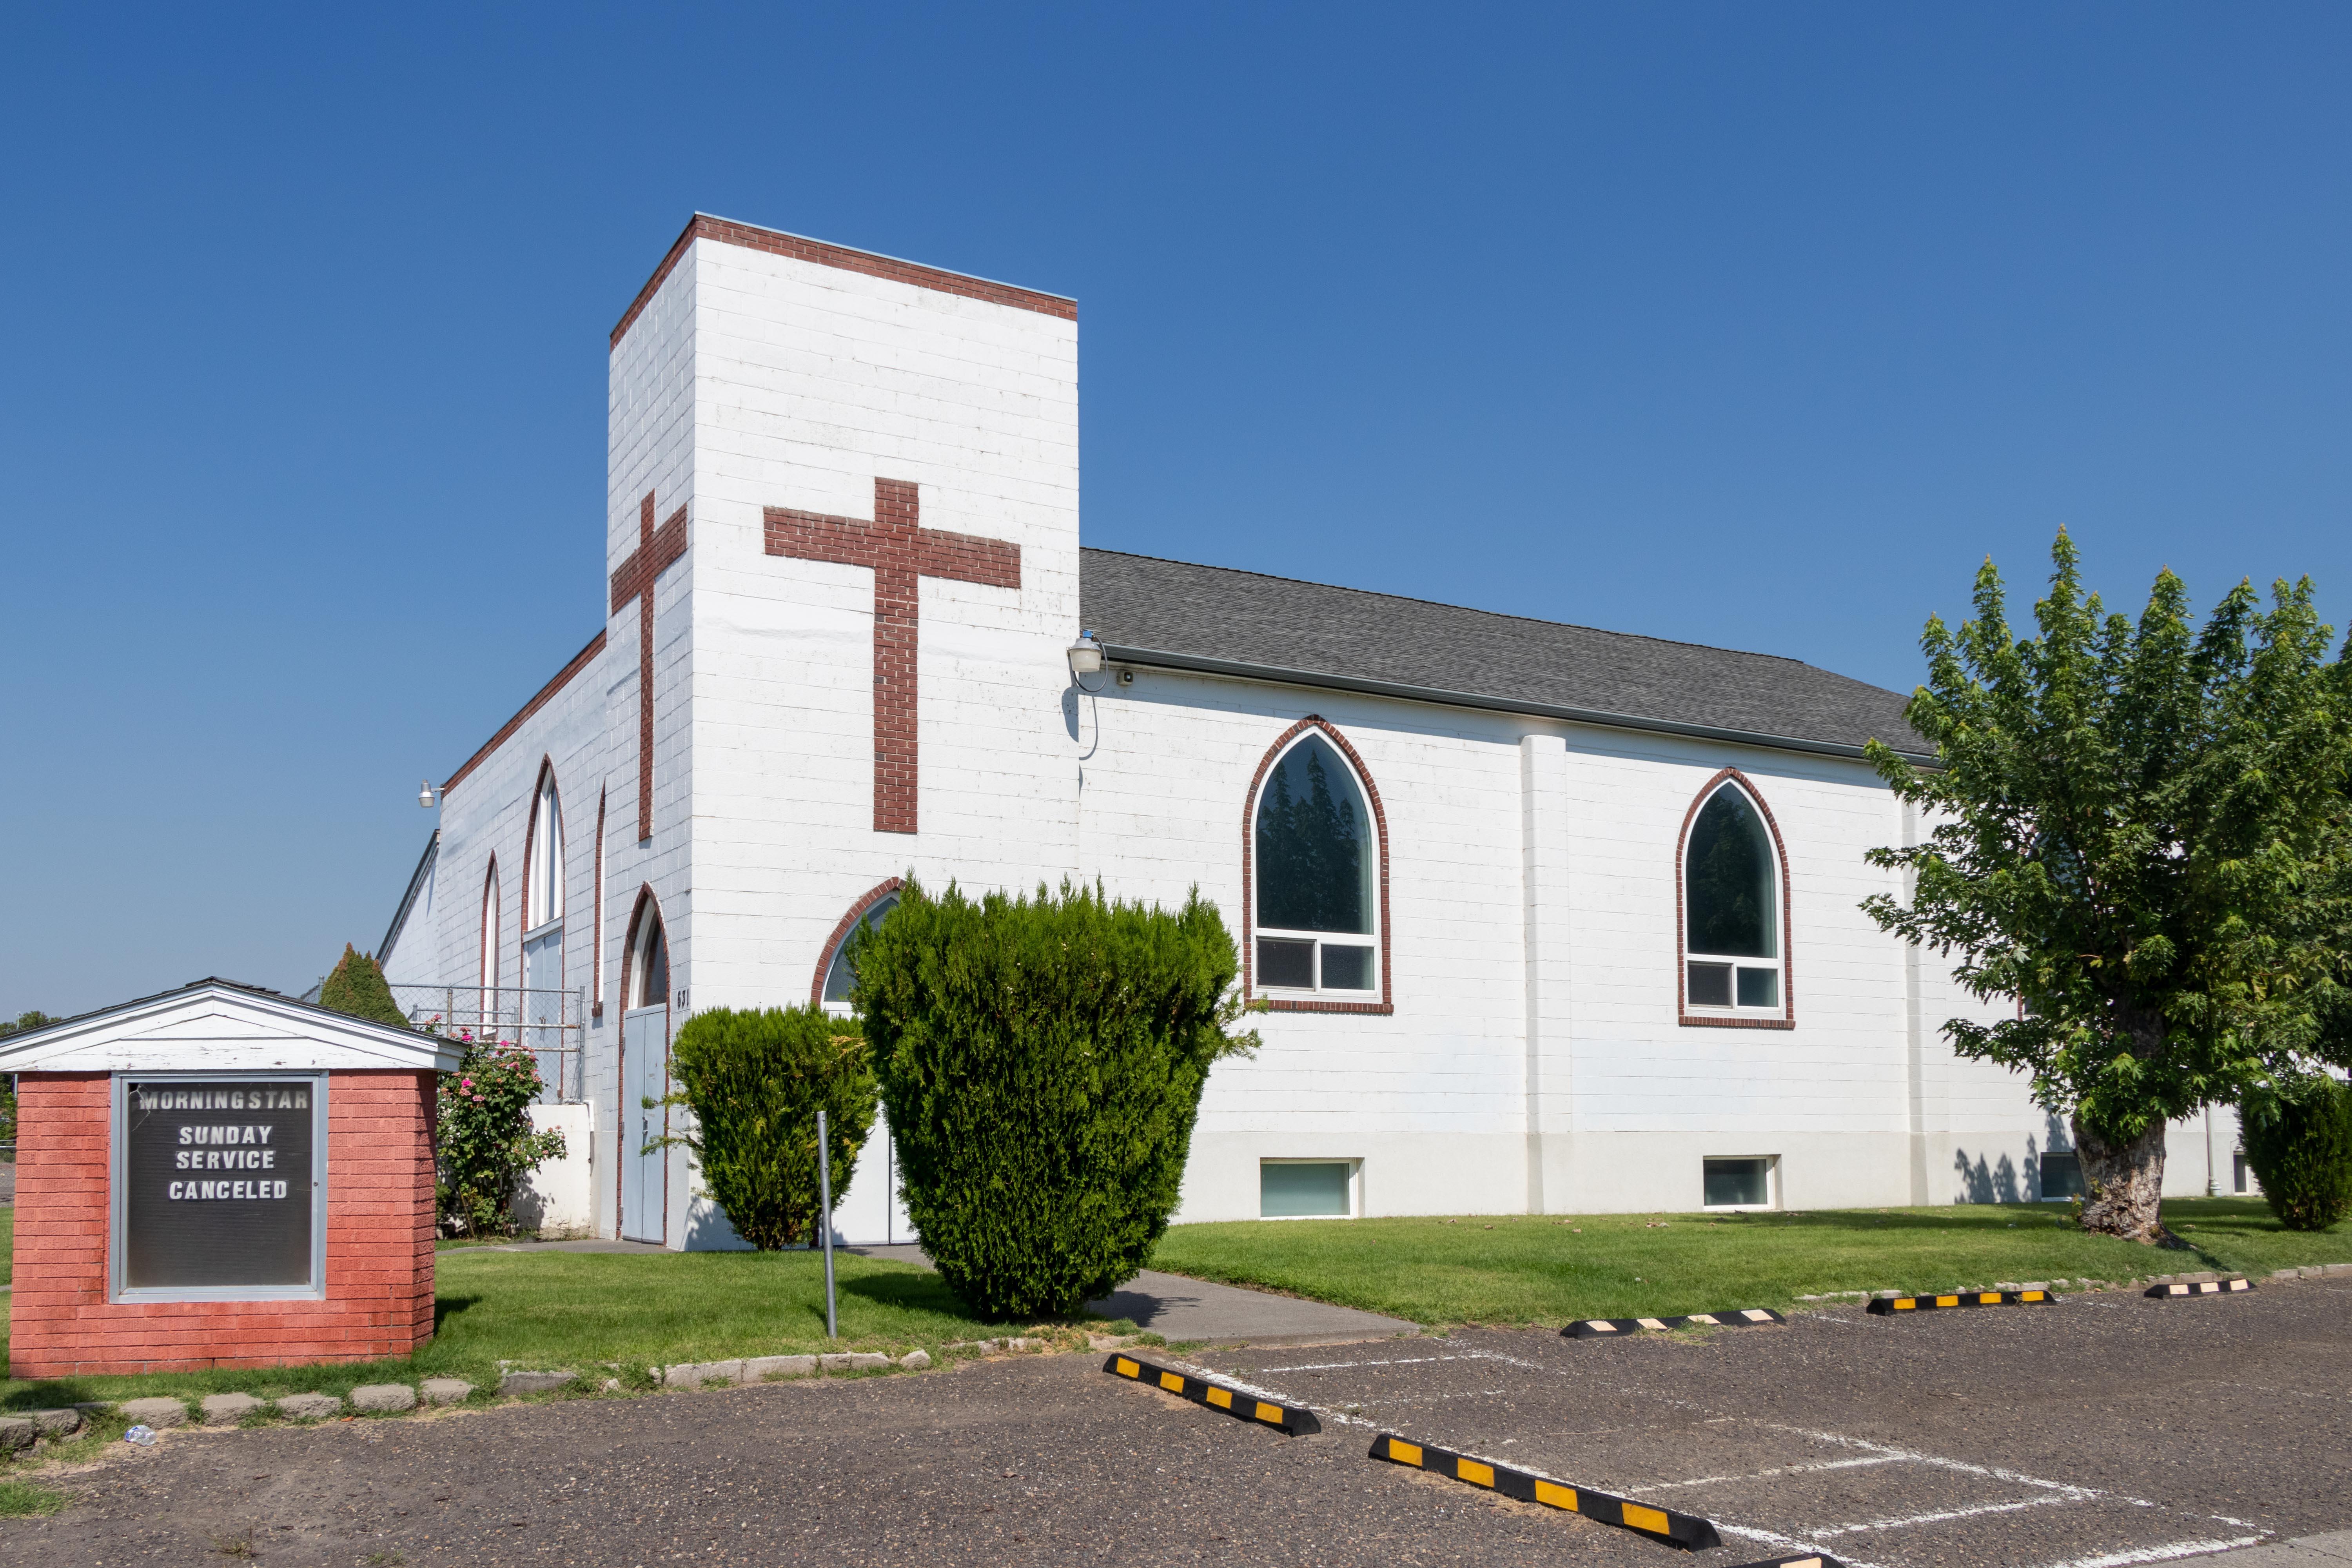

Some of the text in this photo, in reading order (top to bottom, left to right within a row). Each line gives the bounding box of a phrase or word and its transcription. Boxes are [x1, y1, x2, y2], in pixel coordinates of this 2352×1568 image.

[677, 988, 689, 1010] 631
[140, 1091, 307, 1109] MORNINGSTAR
[180, 1126, 272, 1144] SUNDAY
[176, 1151, 274, 1169] SERVICE
[169, 1180, 287, 1199] CANCELED
